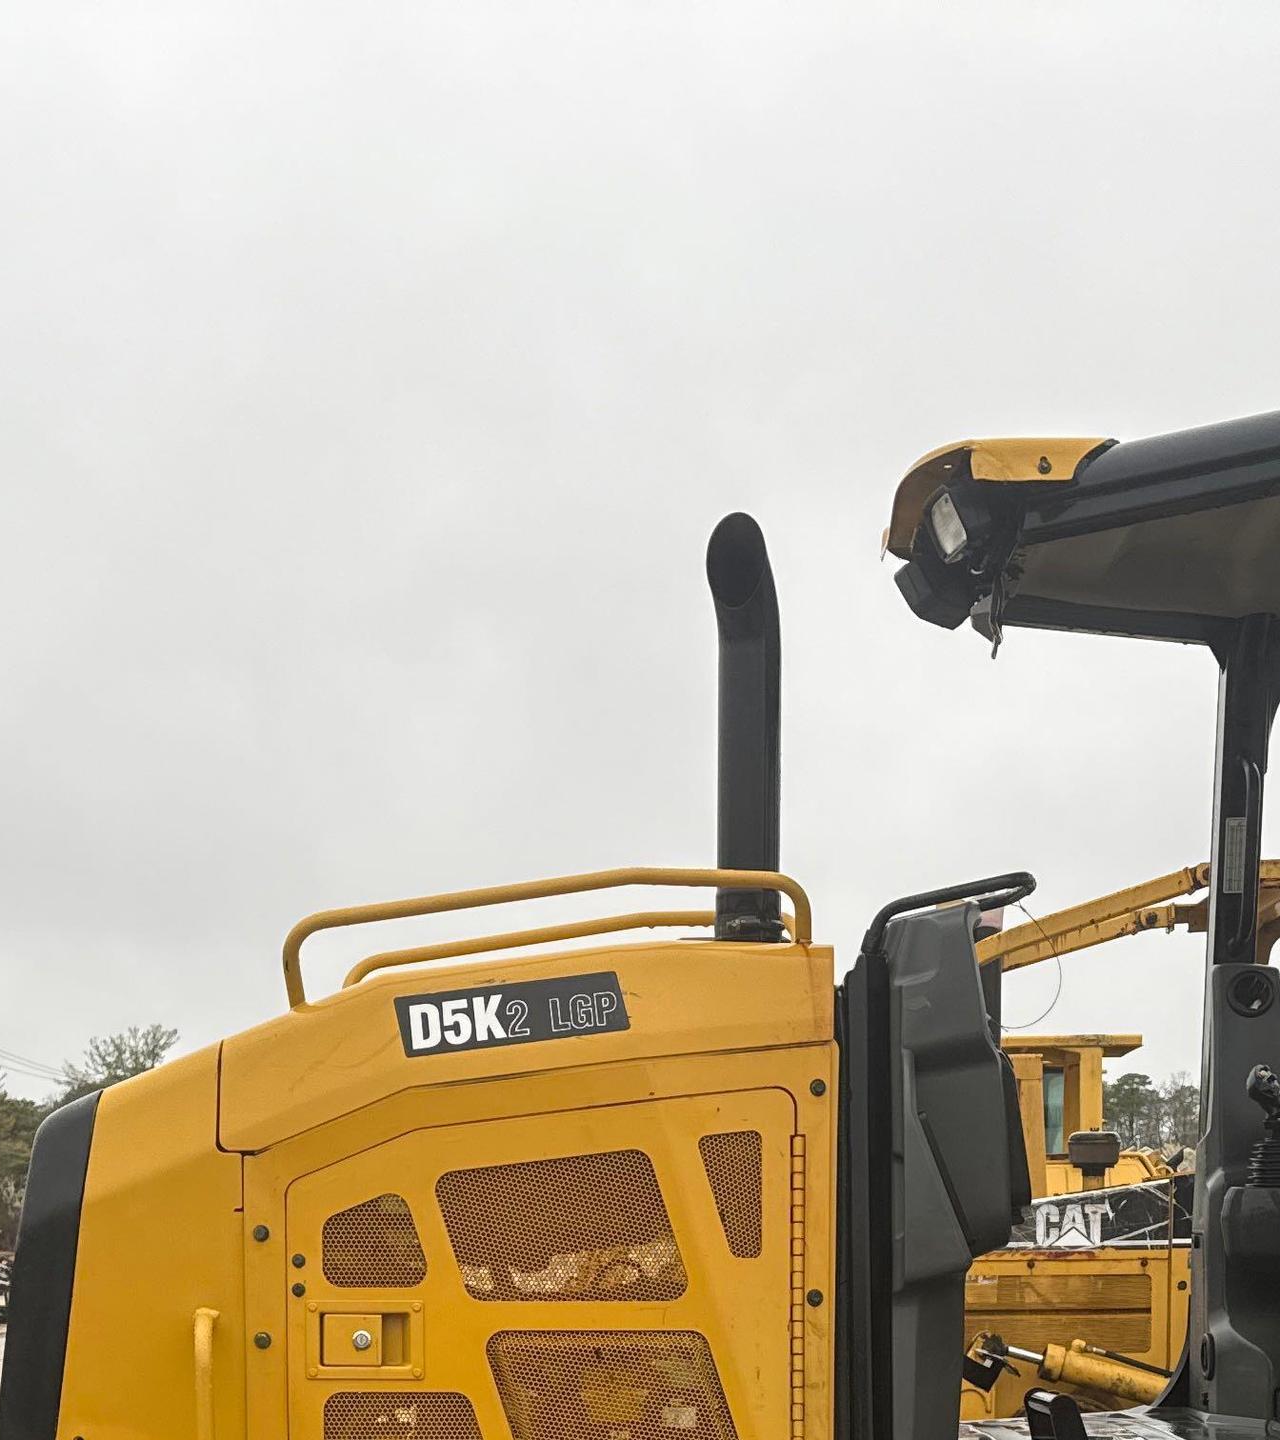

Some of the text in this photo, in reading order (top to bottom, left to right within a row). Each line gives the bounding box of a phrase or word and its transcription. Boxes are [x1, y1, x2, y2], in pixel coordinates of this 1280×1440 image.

[409, 991, 617, 1049] D5K2 LGP
[1035, 1203, 1108, 1246] CAT
